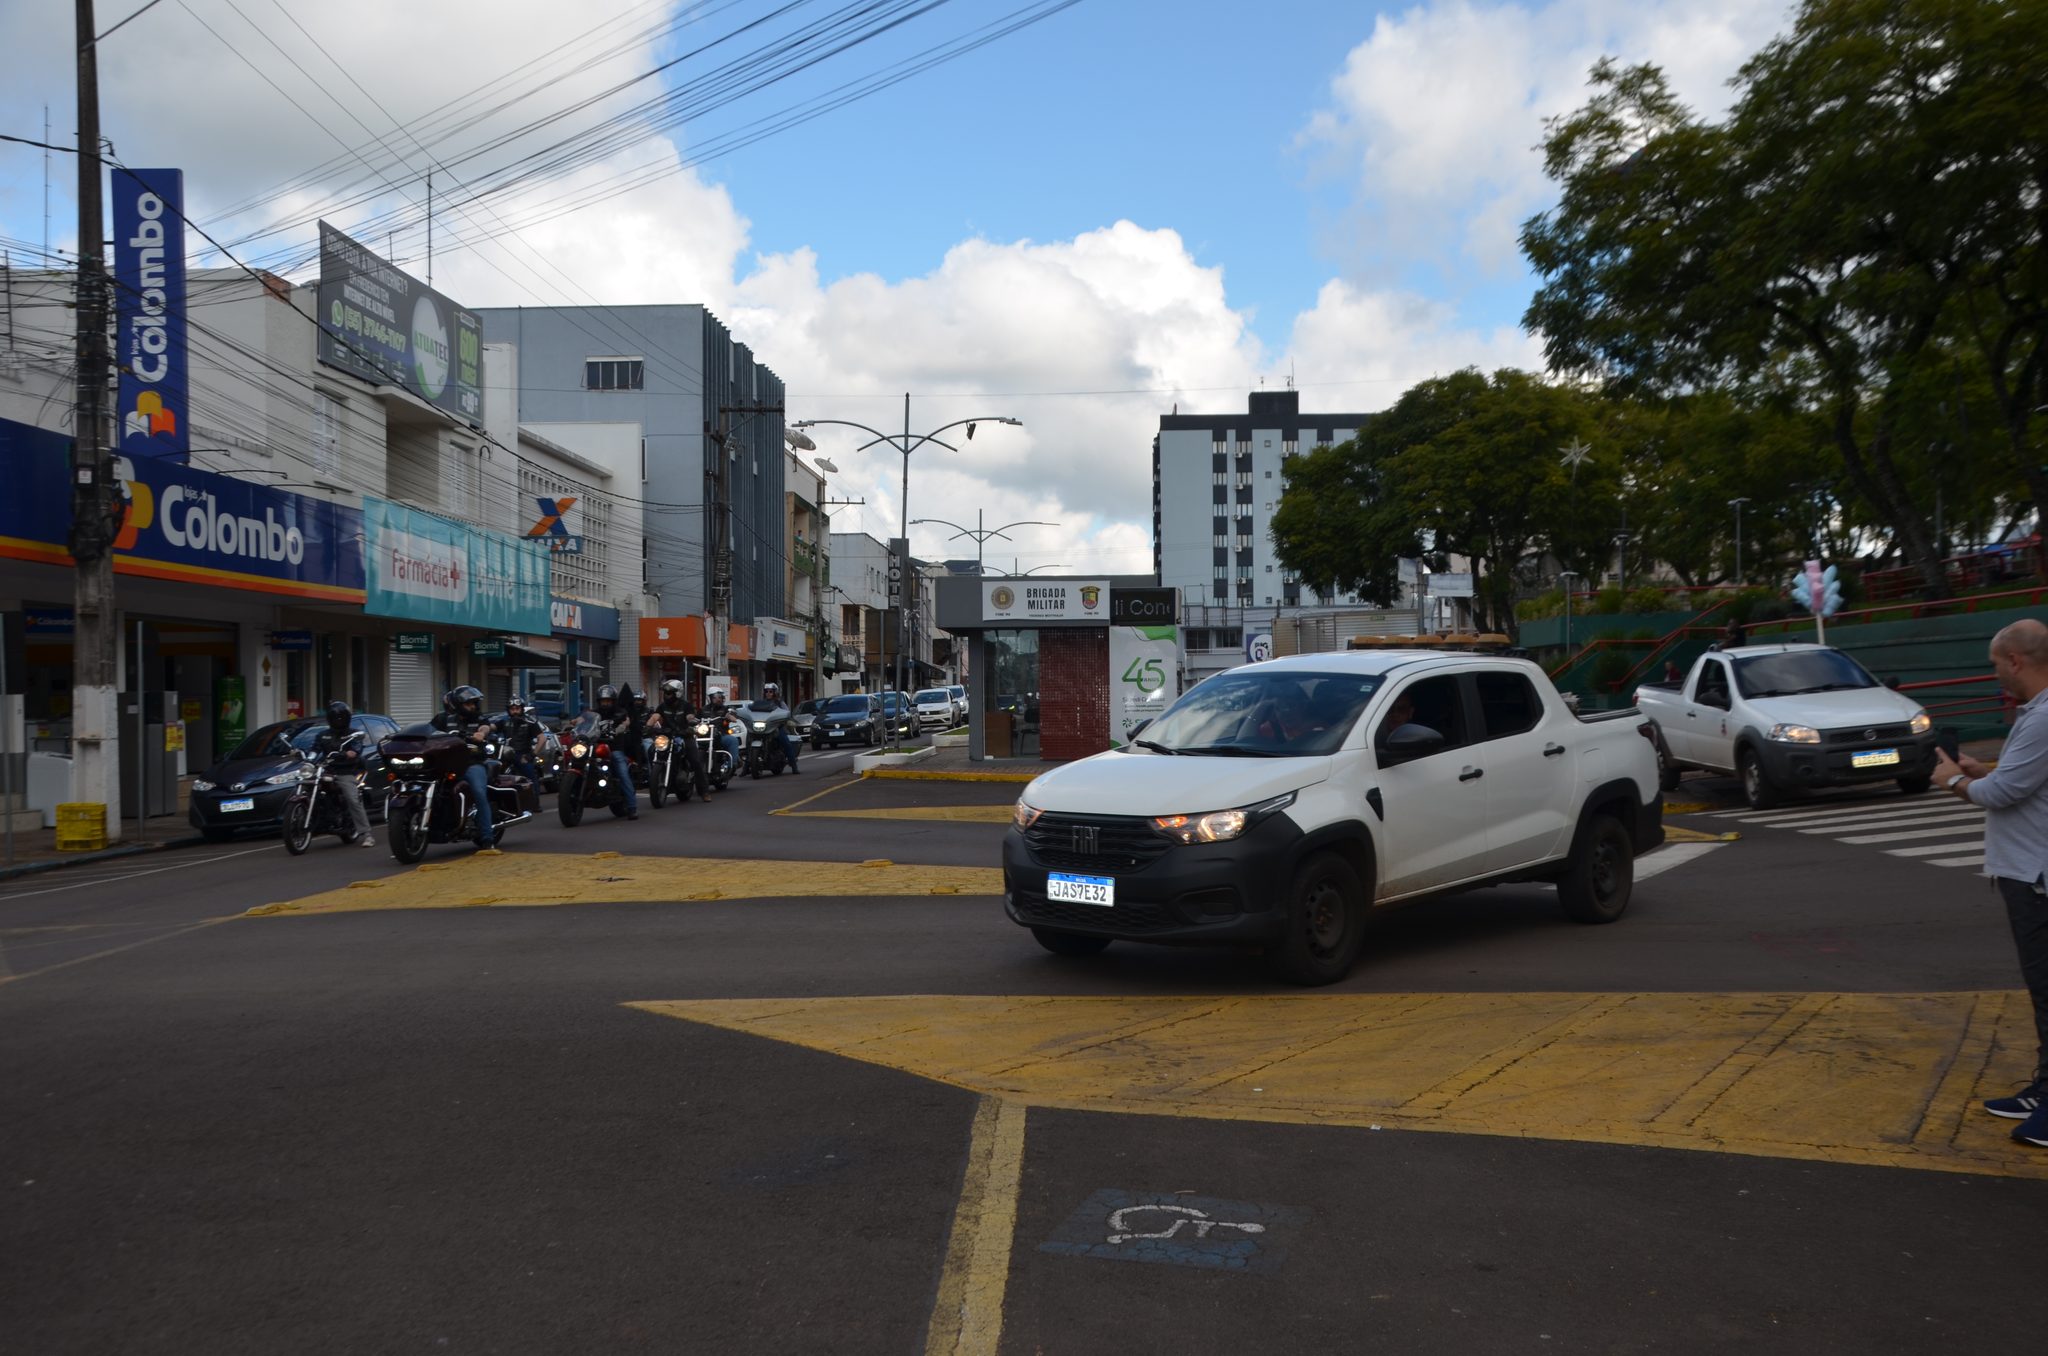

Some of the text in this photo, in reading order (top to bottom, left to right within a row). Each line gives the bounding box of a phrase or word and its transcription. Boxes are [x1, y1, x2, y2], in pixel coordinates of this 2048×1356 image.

[129, 191, 168, 384] Colombo
[414, 329, 448, 363] ATUATEC
[184, 484, 198, 502] lojas
[160, 484, 304, 565] Colombo
[528, 537, 577, 551] IXA
[1026, 588, 1066, 599] BRIGADA
[1027, 599, 1065, 610] MILITAR
[551, 600, 582, 631] CAIXA
[400, 635, 429, 645] Biomê
[474, 641, 500, 651] Biomê
[1122, 656, 1166, 694] 45
[1071, 825, 1101, 855] FIAT
[1053, 881, 1107, 902] JAS7E32
